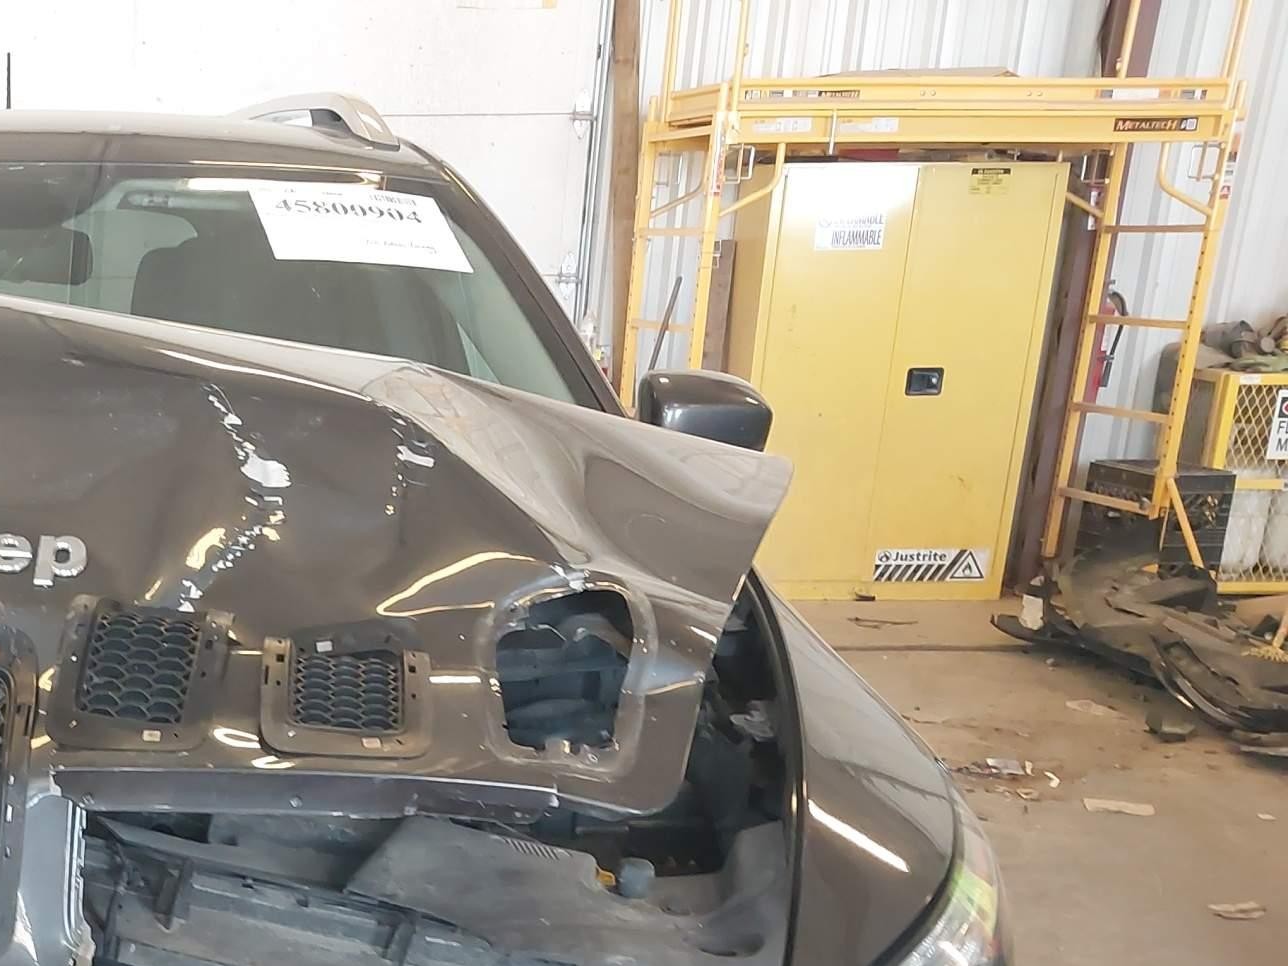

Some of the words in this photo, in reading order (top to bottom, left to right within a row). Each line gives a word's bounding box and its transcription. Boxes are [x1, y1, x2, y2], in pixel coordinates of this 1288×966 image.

[274, 199, 422, 223] 45800904
[832, 229, 882, 246] INFLAMMABLE
[892, 550, 947, 562] Justrite
